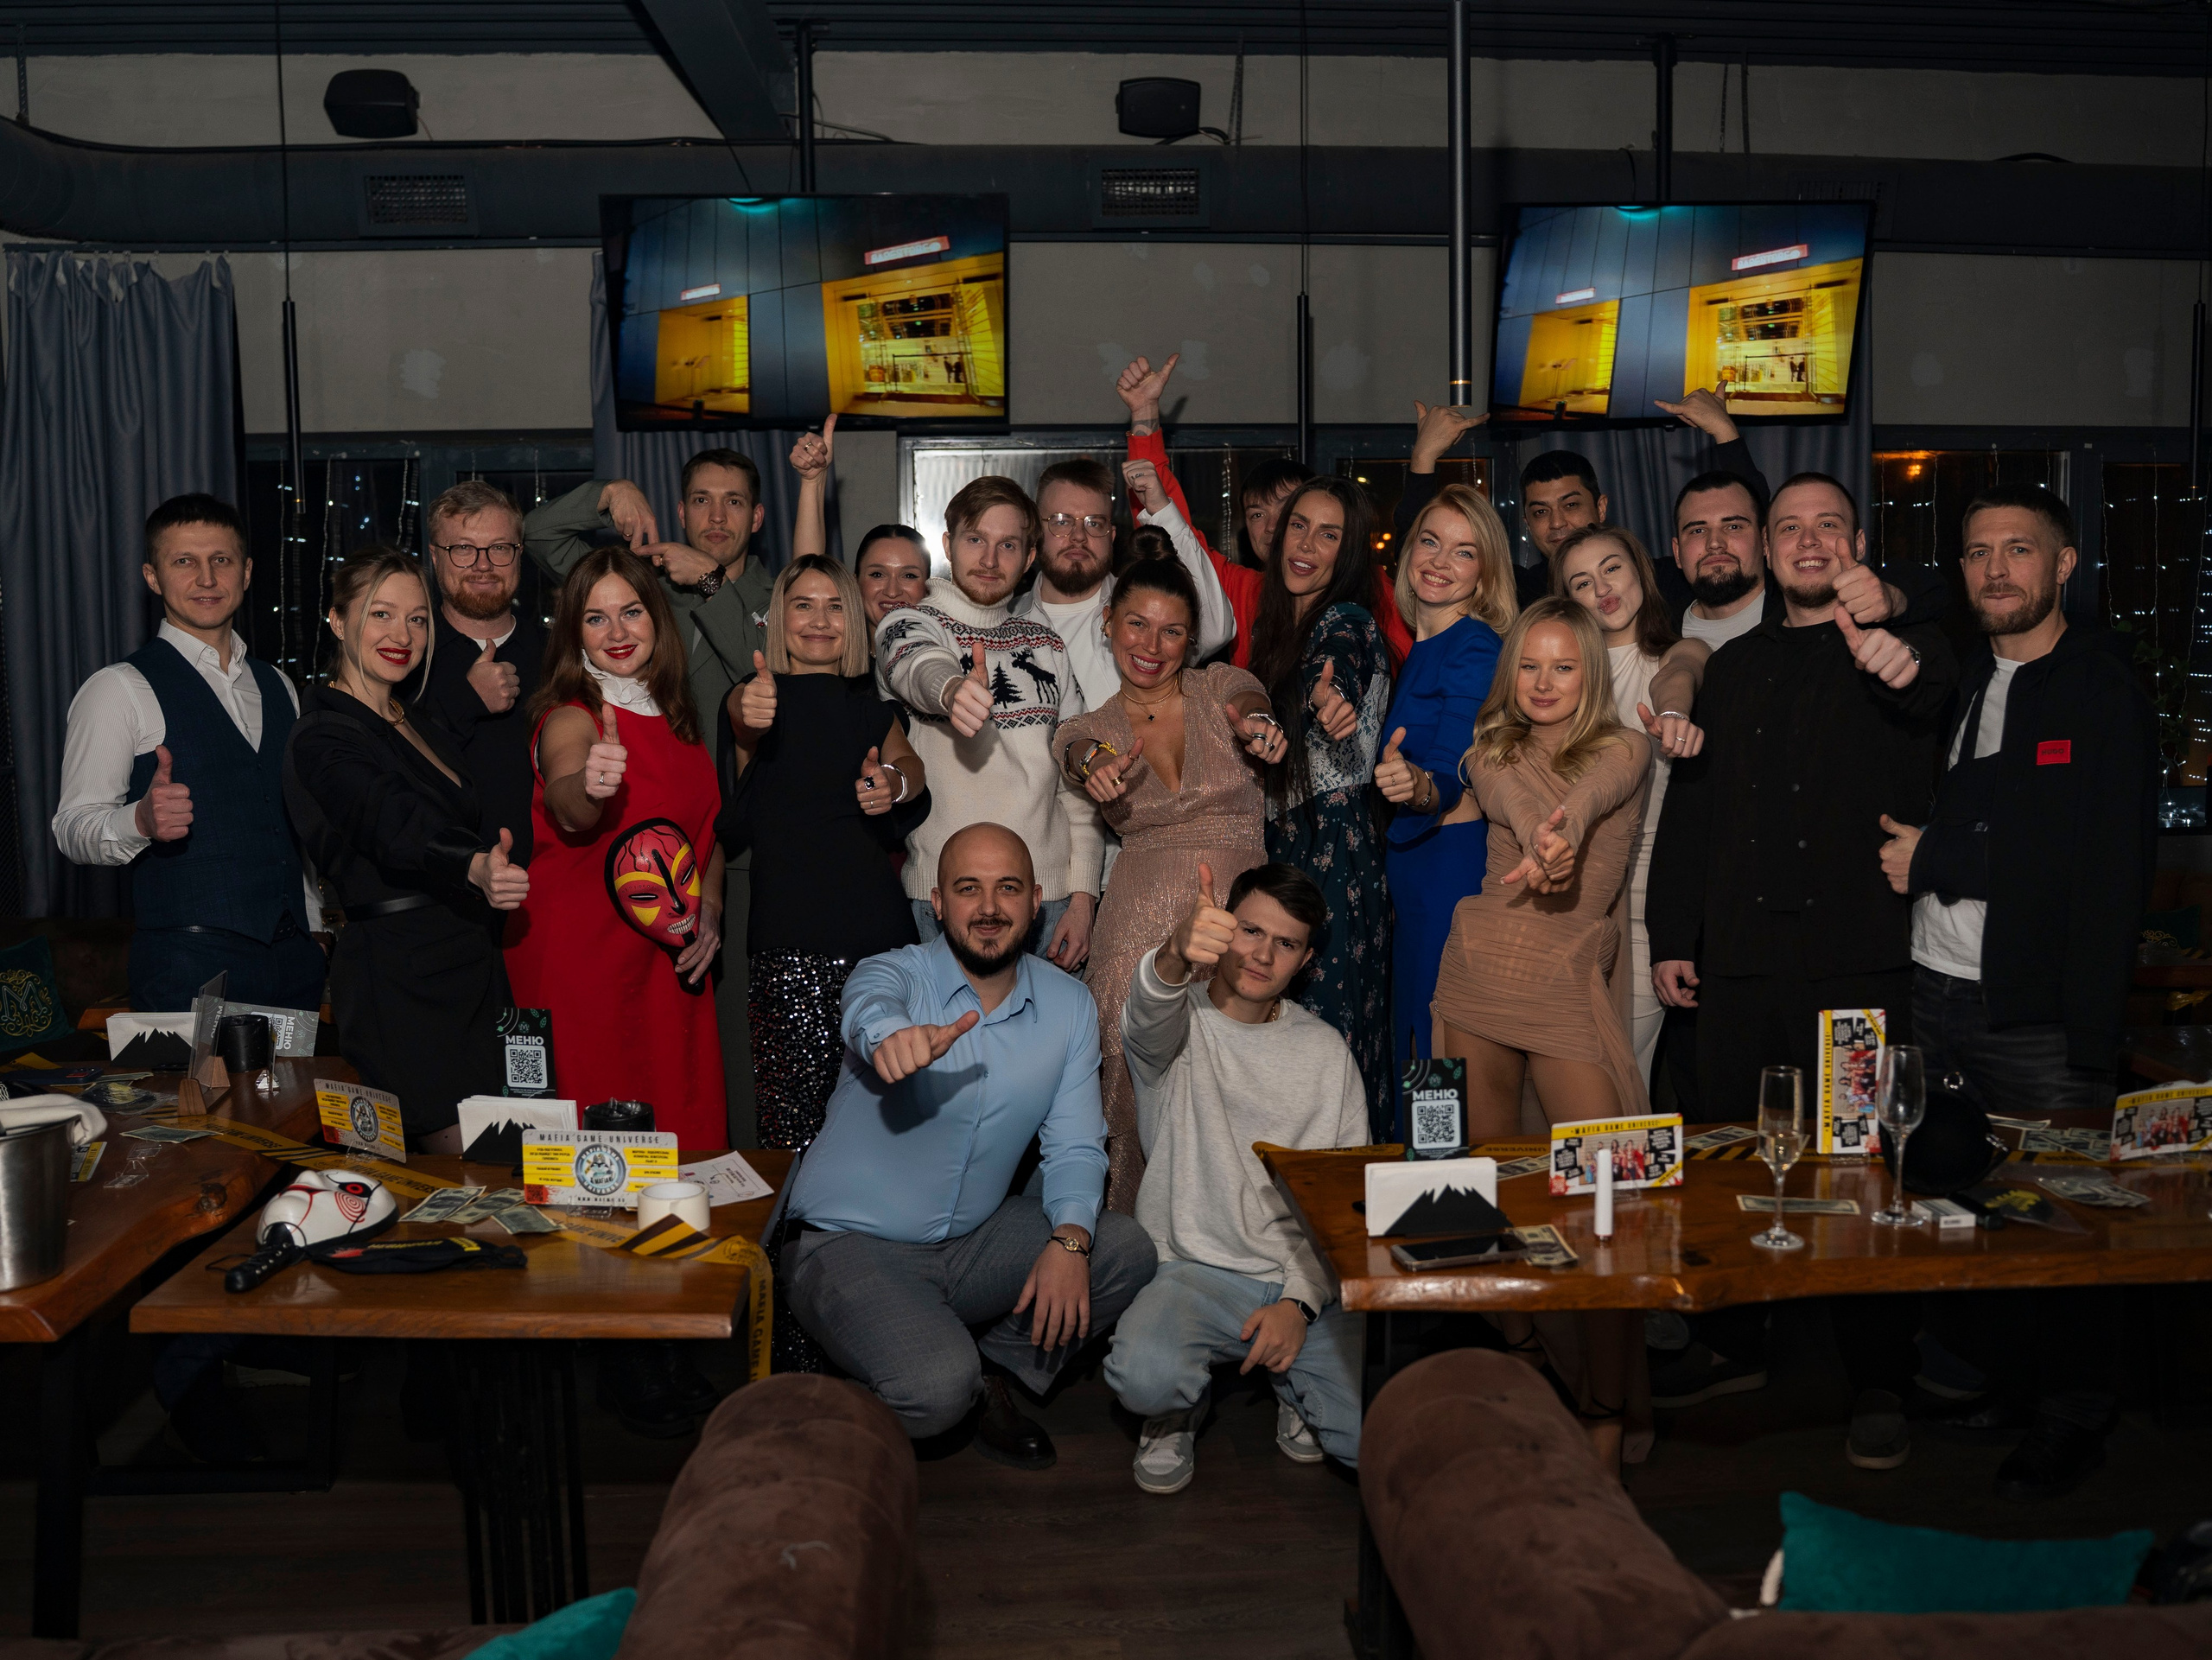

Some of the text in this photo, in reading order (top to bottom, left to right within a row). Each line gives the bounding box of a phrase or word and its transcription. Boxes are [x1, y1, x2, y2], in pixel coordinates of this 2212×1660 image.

[283, 1016, 296, 1050] МЕНЮ
[505, 1035, 544, 1046] МЕНЮ
[1412, 1088, 1459, 1101] МЕНЮ
[609, 1135, 660, 1144] UNIVERSE
[755, 1279, 766, 1325] MAFIA
[751, 1328, 764, 1368] GAME
